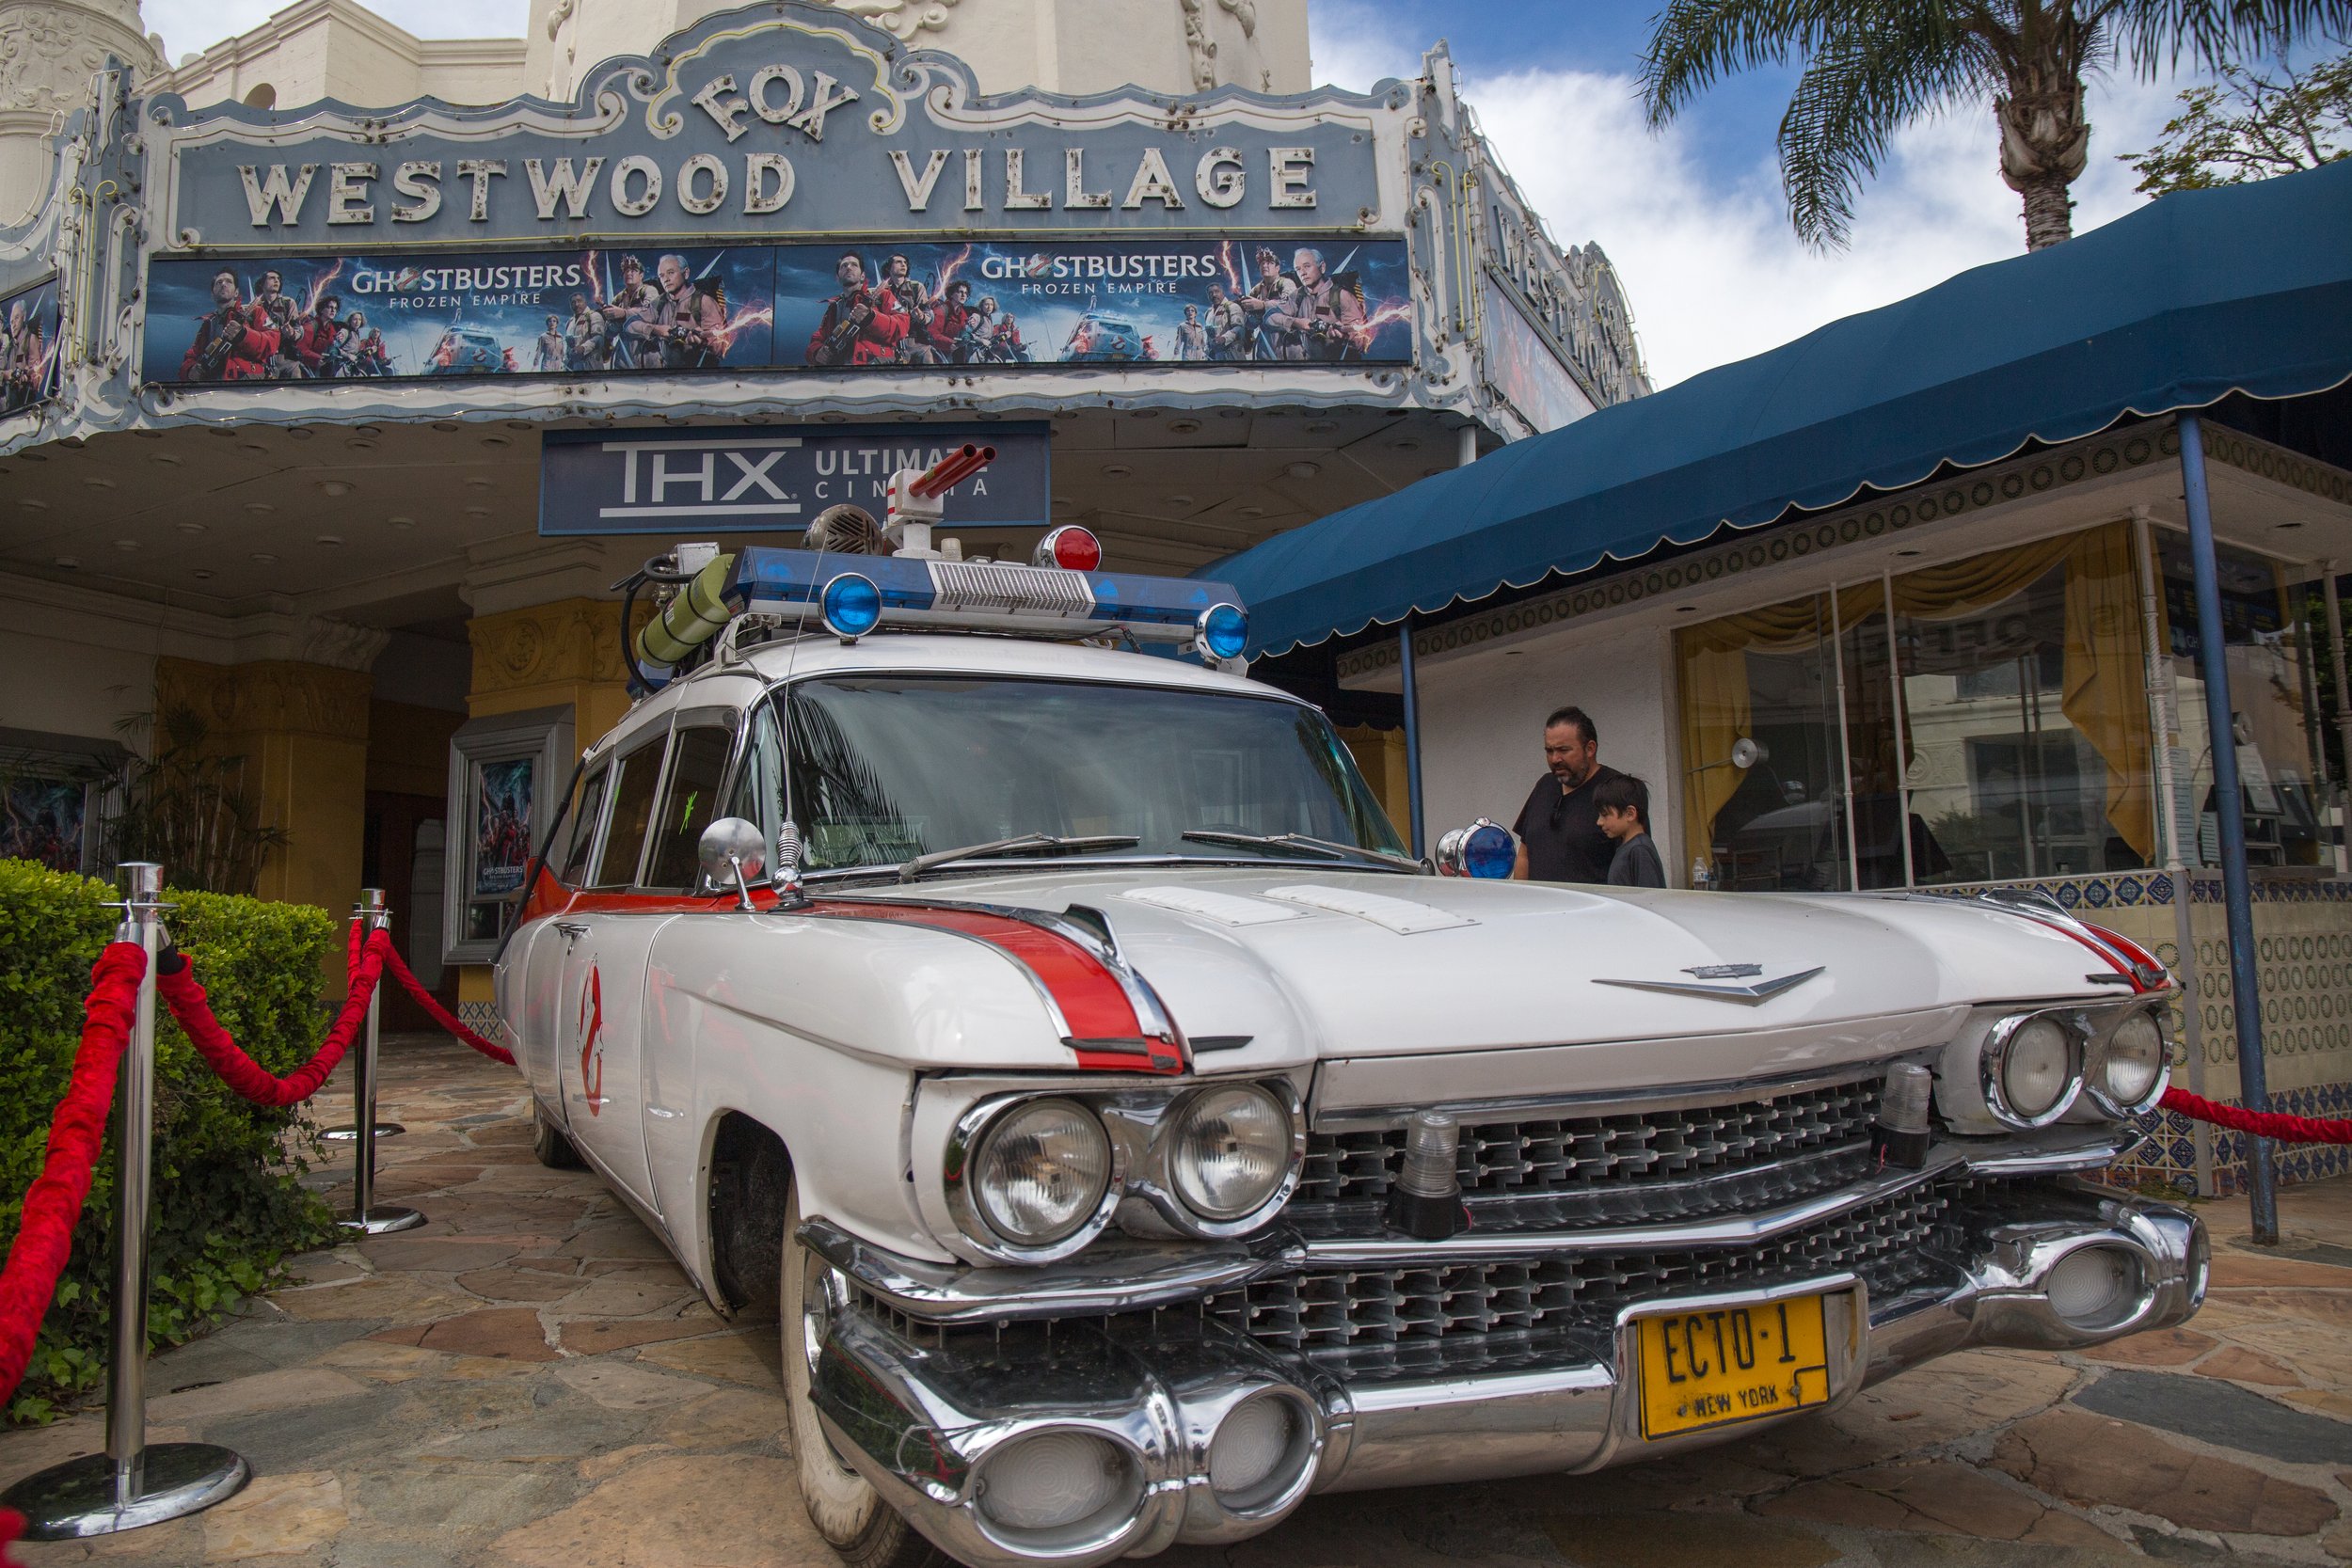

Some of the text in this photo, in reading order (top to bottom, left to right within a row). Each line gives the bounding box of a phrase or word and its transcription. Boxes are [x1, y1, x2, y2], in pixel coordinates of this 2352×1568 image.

[691, 63, 860, 143] FOX
[236, 147, 1317, 228] WESTWOOD VILLAGE
[389, 293, 540, 309] FROZEN EMPIRE
[1022, 282, 1177, 294] FROZEN EMPIRE
[601, 437, 803, 504] THX
[815, 447, 988, 476] ULTIMA
[1695, 1385, 1779, 1418] NEW YORK
